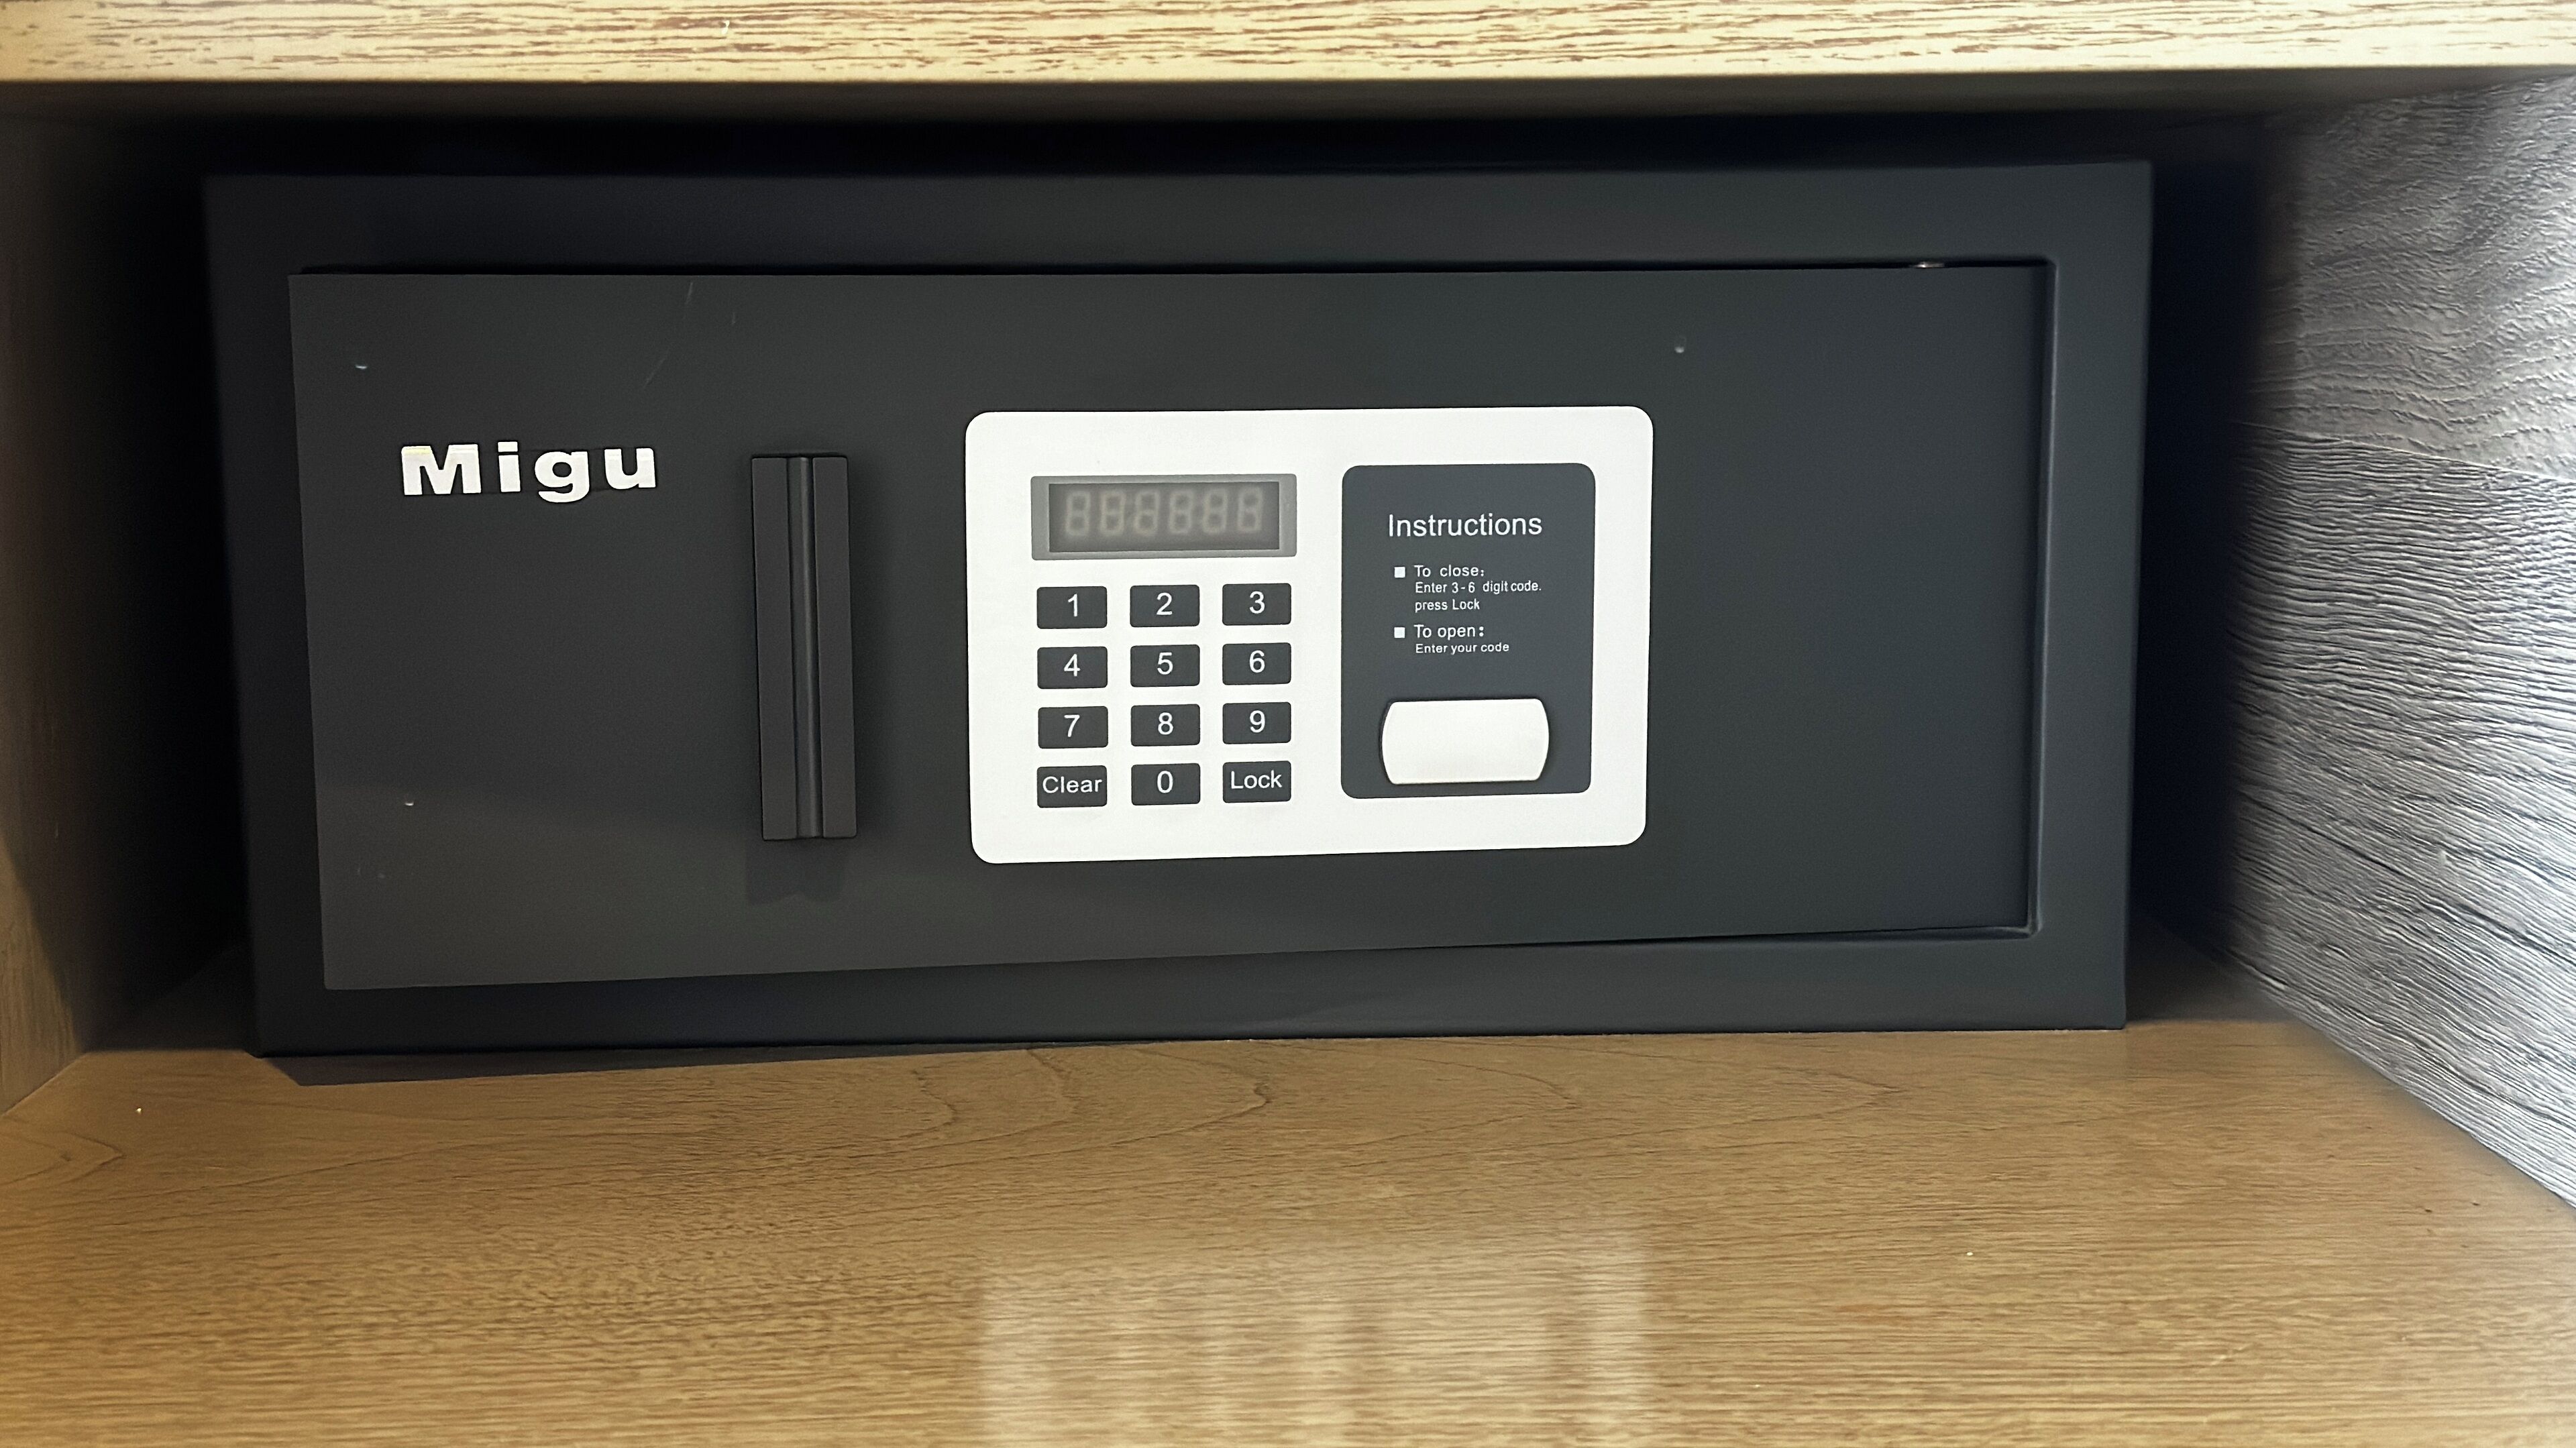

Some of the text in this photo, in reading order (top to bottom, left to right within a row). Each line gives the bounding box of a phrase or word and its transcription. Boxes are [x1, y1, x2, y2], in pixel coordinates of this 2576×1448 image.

[401, 441, 656, 503] Migu
[1389, 512, 1542, 537] Instructions
[1413, 565, 1432, 577] To
[1415, 581, 1448, 594] Enter
[1482, 580, 1509, 595] digit
[1067, 591, 1265, 618] 1 2 3
[1415, 598, 1481, 613] press Lock
[1413, 624, 1432, 638] To
[1415, 642, 1510, 656] Enter your code
[1063, 650, 1266, 677] 4 5 6
[1064, 710, 1266, 738] 7 8 9
[1042, 769, 1283, 794] Clear 0 Lock
